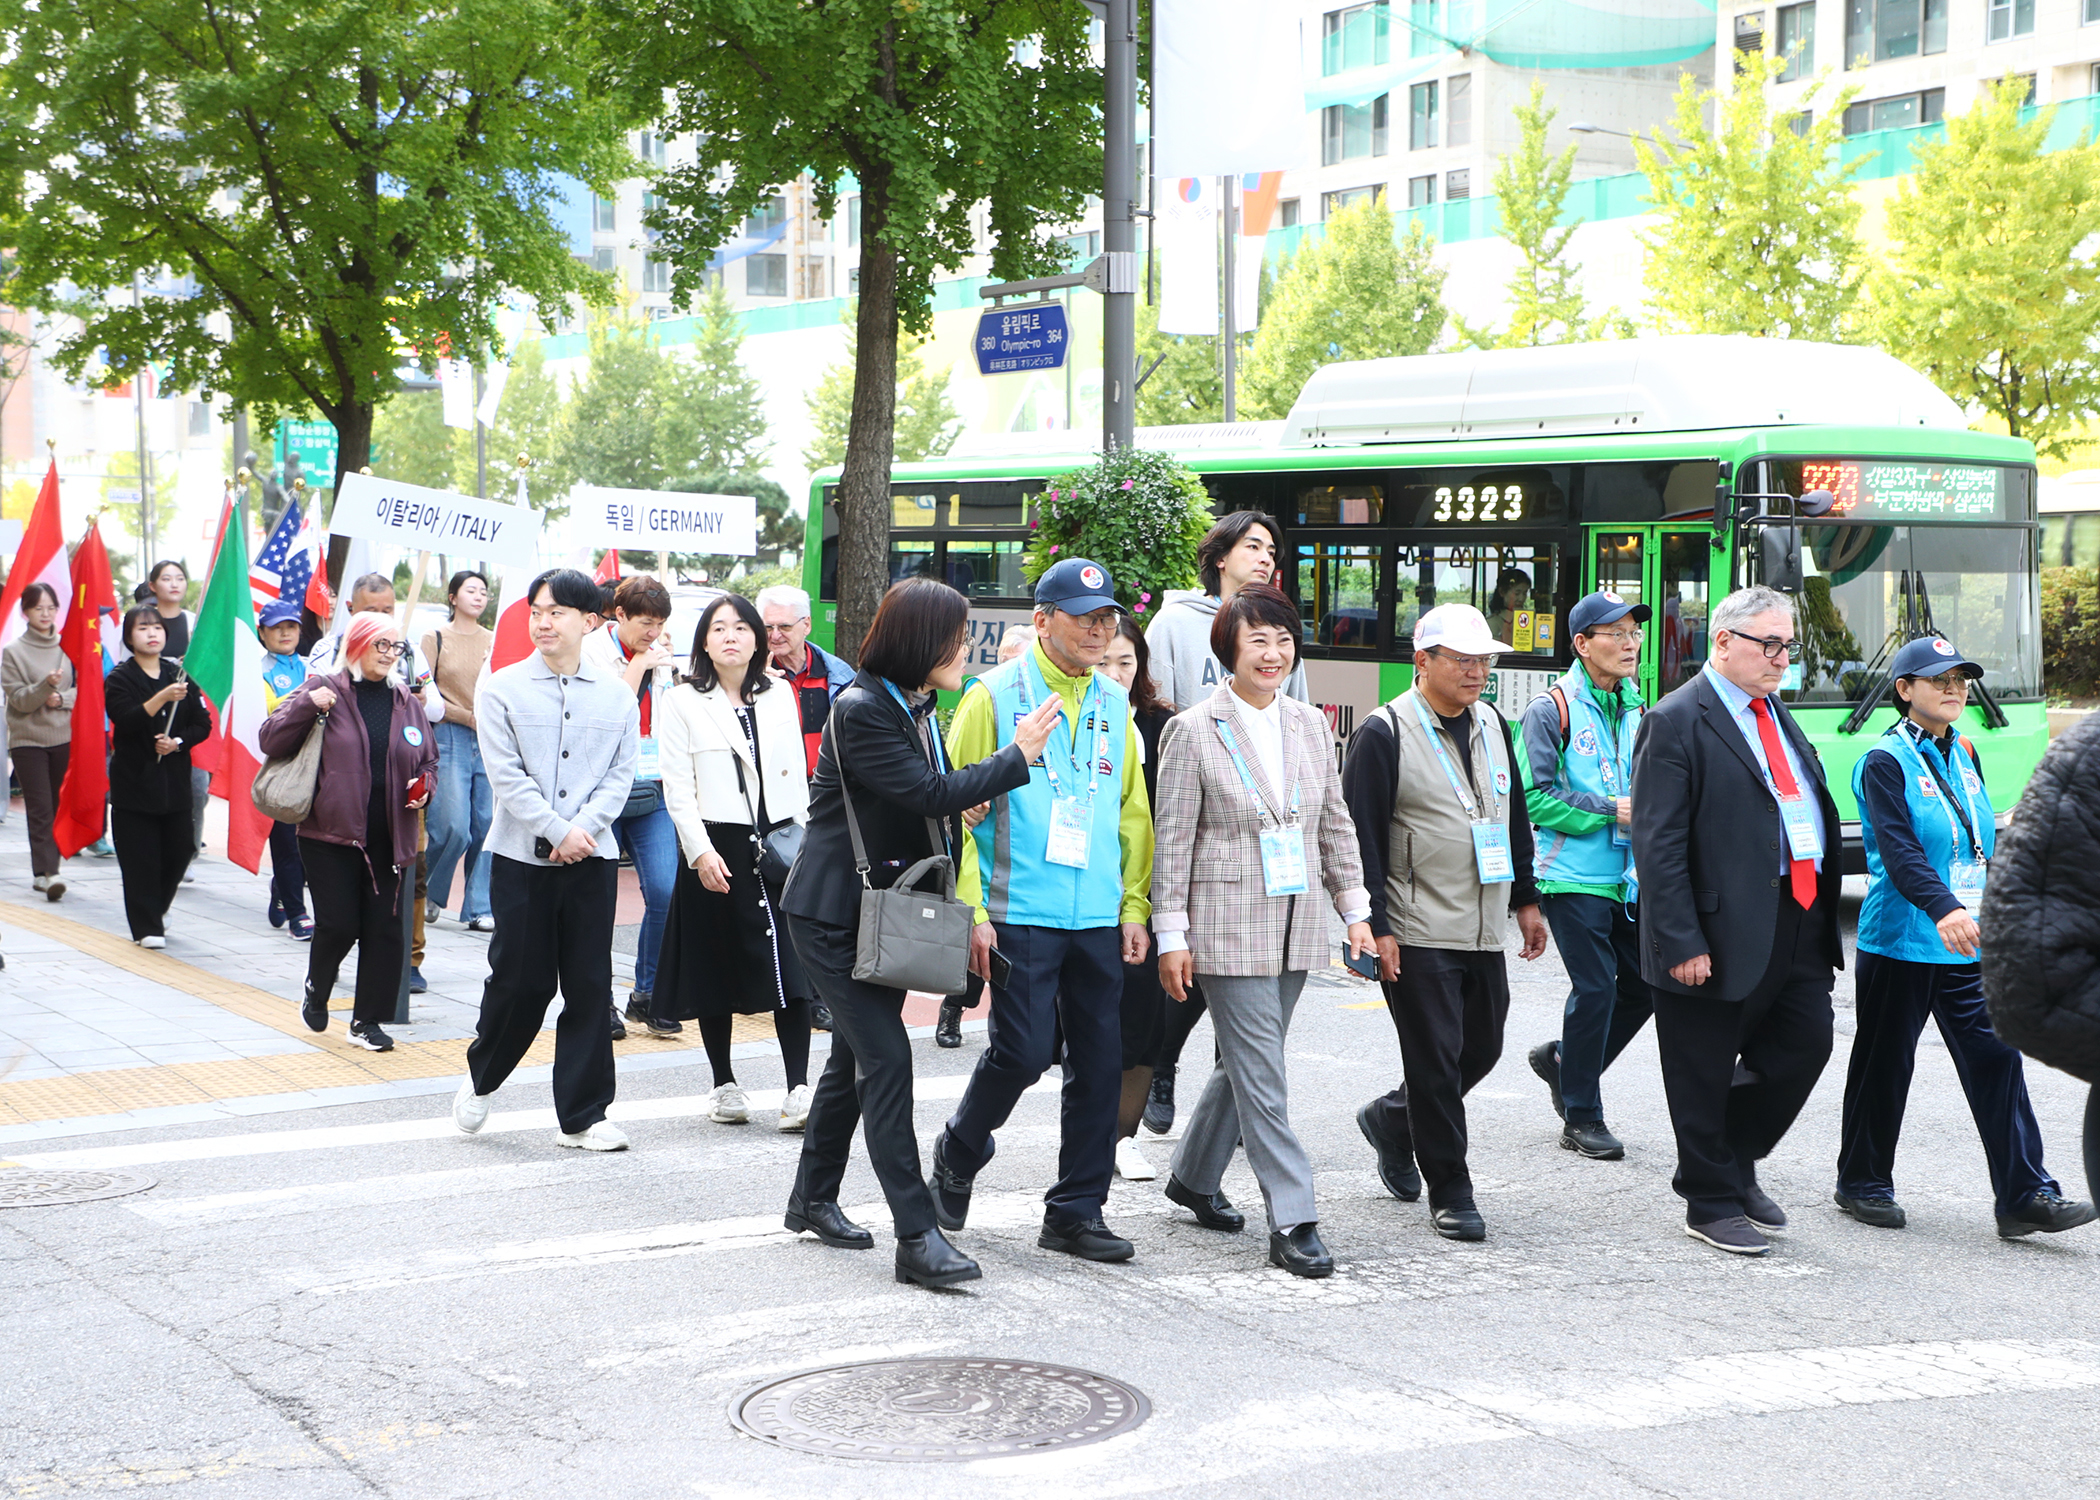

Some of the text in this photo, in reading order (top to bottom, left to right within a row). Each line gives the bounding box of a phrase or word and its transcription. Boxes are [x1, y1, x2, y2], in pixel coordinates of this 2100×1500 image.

[1001, 313, 1041, 336] 올림픽로
[981, 336, 996, 350] 360
[1001, 338, 1041, 353] Olympic-ro
[1046, 329, 1062, 344] 364
[1434, 485, 1522, 521] 3323
[376, 497, 440, 534] 이탈리아
[451, 513, 502, 543] ITALY
[605, 503, 634, 532] 독일
[648, 508, 724, 534] GERMANY
